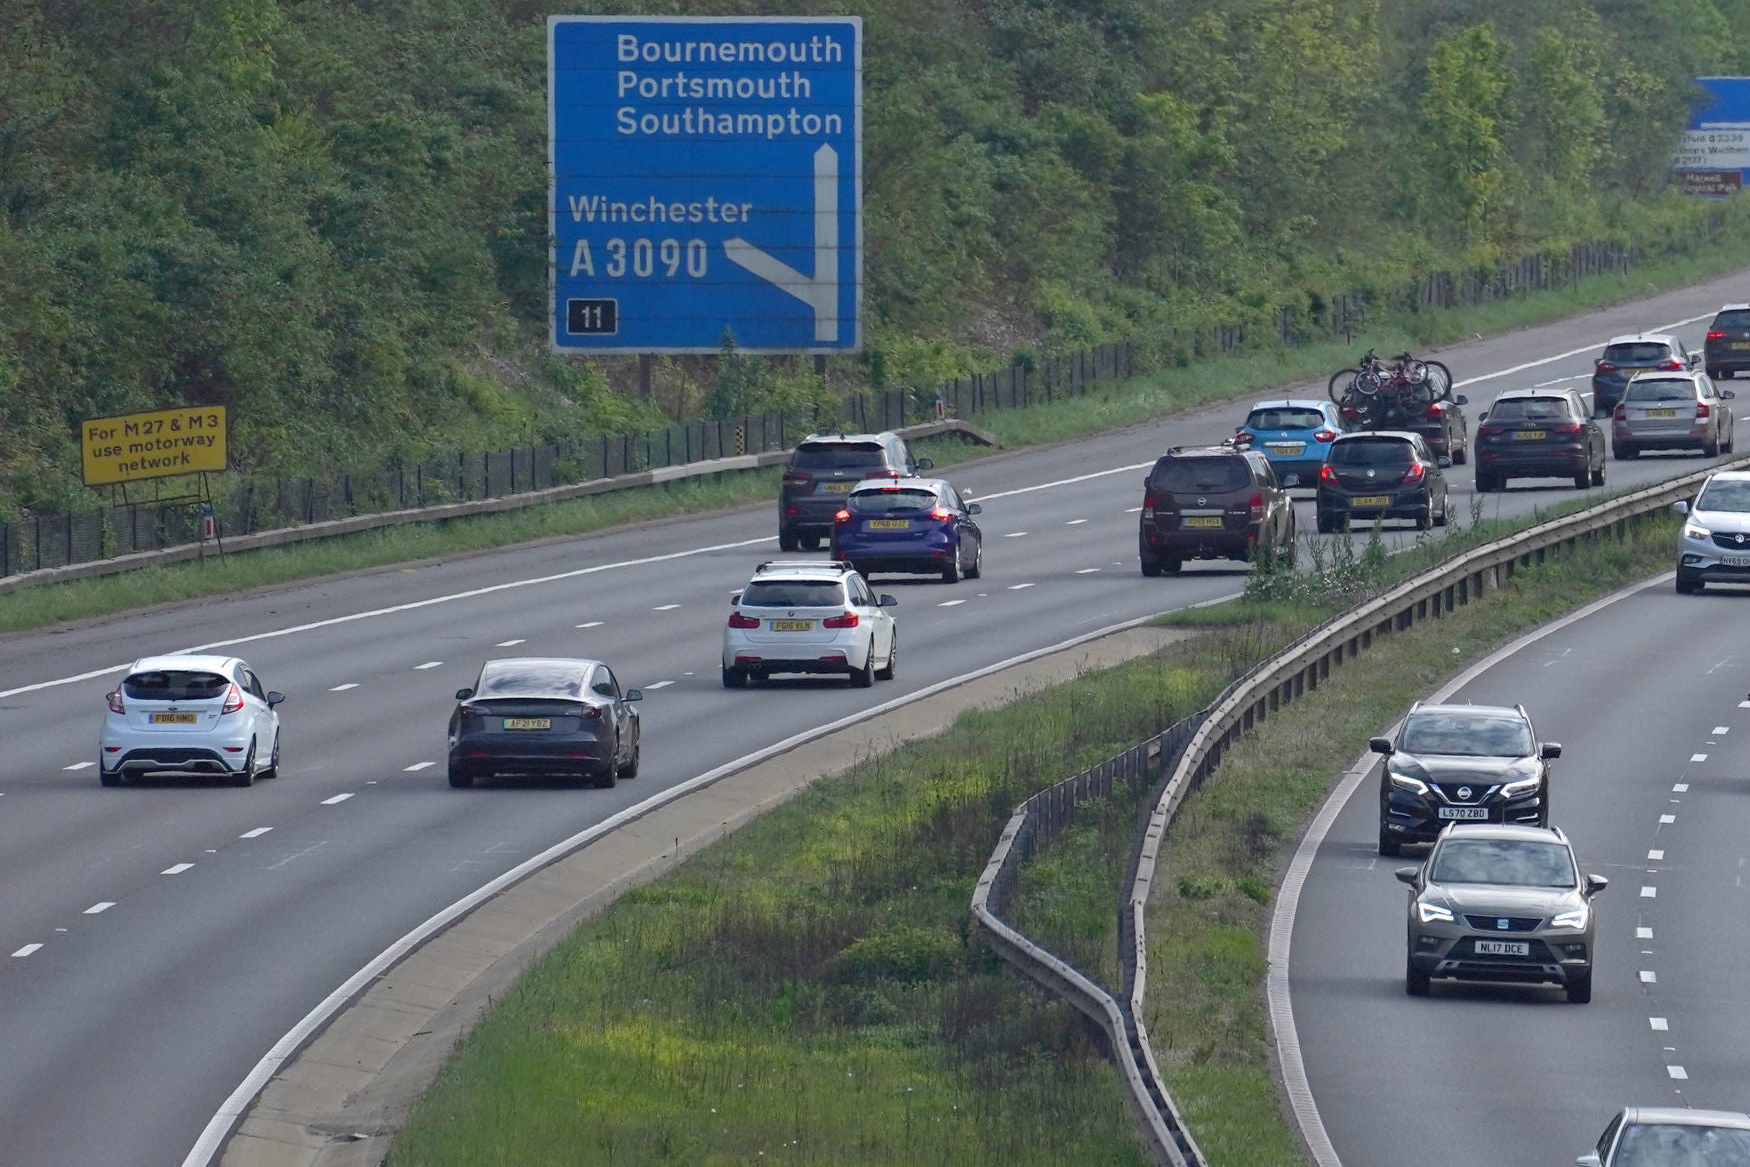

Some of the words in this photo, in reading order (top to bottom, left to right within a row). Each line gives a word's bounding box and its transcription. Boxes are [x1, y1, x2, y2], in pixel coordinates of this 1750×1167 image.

[616, 34, 843, 63] Bournemouth
[617, 70, 812, 99] Portsmouth
[616, 107, 843, 140] Southampton
[568, 195, 754, 224] Winchester
[580, 306, 603, 330] 11
[89, 428, 117, 441] For
[170, 418, 182, 431] &
[93, 446, 122, 458] use
[129, 435, 216, 454] motorway
[119, 452, 190, 472] network
[510, 719, 530, 728] AF21
[531, 719, 548, 728] YBZ
[1442, 809, 1465, 818] LS70
[1467, 809, 1484, 819] ZBD
[1480, 942, 1503, 952] NL17
[1504, 943, 1523, 954] DCE
